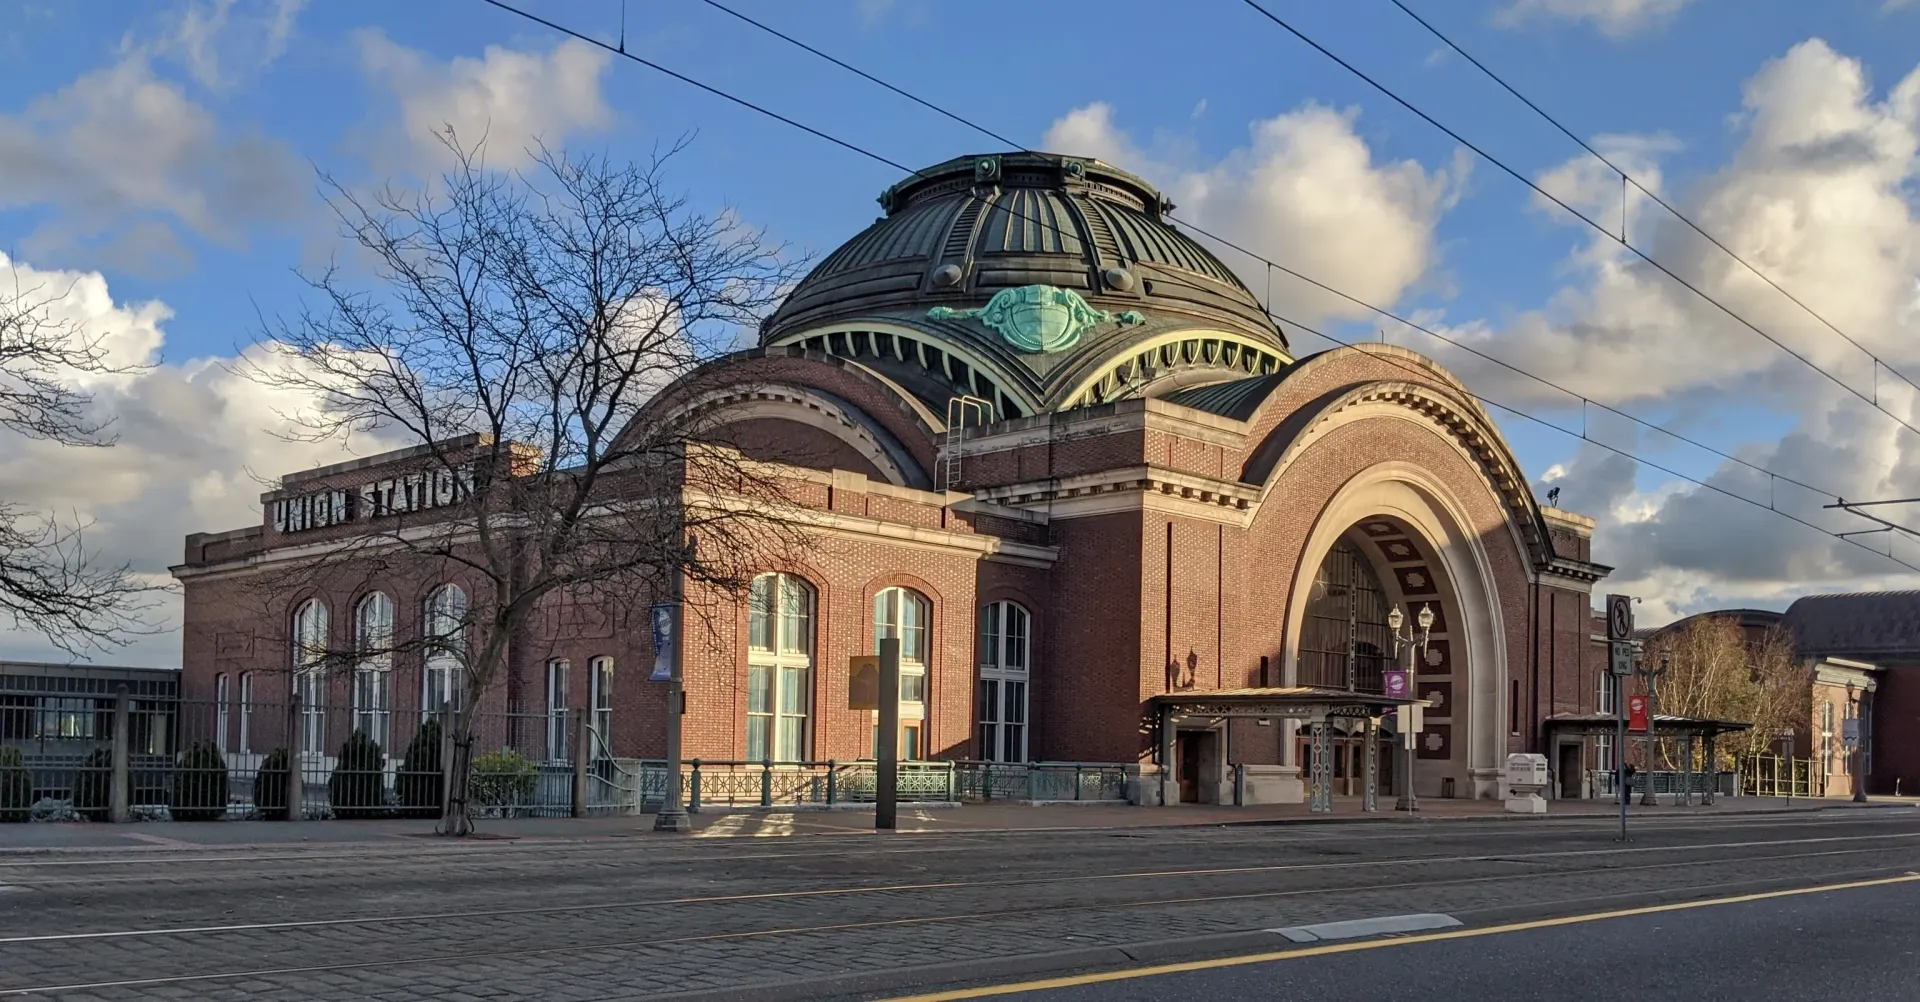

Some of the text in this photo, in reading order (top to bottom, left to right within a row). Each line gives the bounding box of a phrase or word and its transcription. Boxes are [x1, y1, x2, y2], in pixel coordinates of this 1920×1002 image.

[273, 463, 474, 534] UNION STATION
[1614, 647, 1630, 657] NO PED
